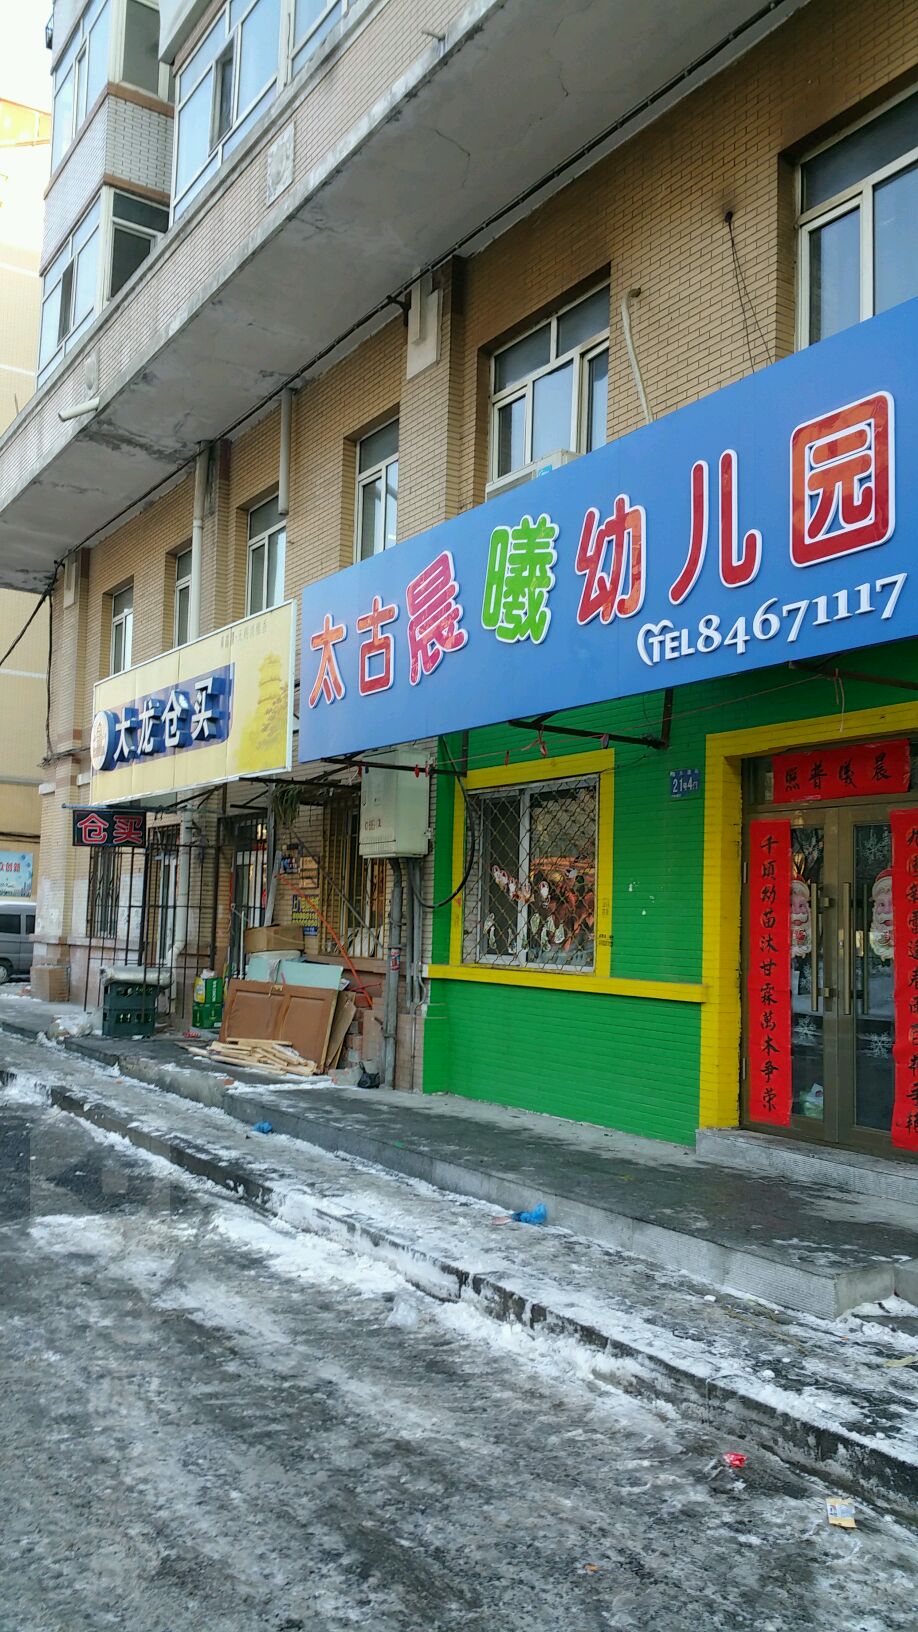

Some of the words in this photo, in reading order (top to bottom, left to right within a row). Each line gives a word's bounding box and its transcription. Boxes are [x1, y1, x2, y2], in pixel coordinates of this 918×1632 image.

[308, 390, 897, 710] 太古晨曦幼儿园
[113, 676, 217, 762] 大龙仓买
[75, 812, 143, 845] 仓买
